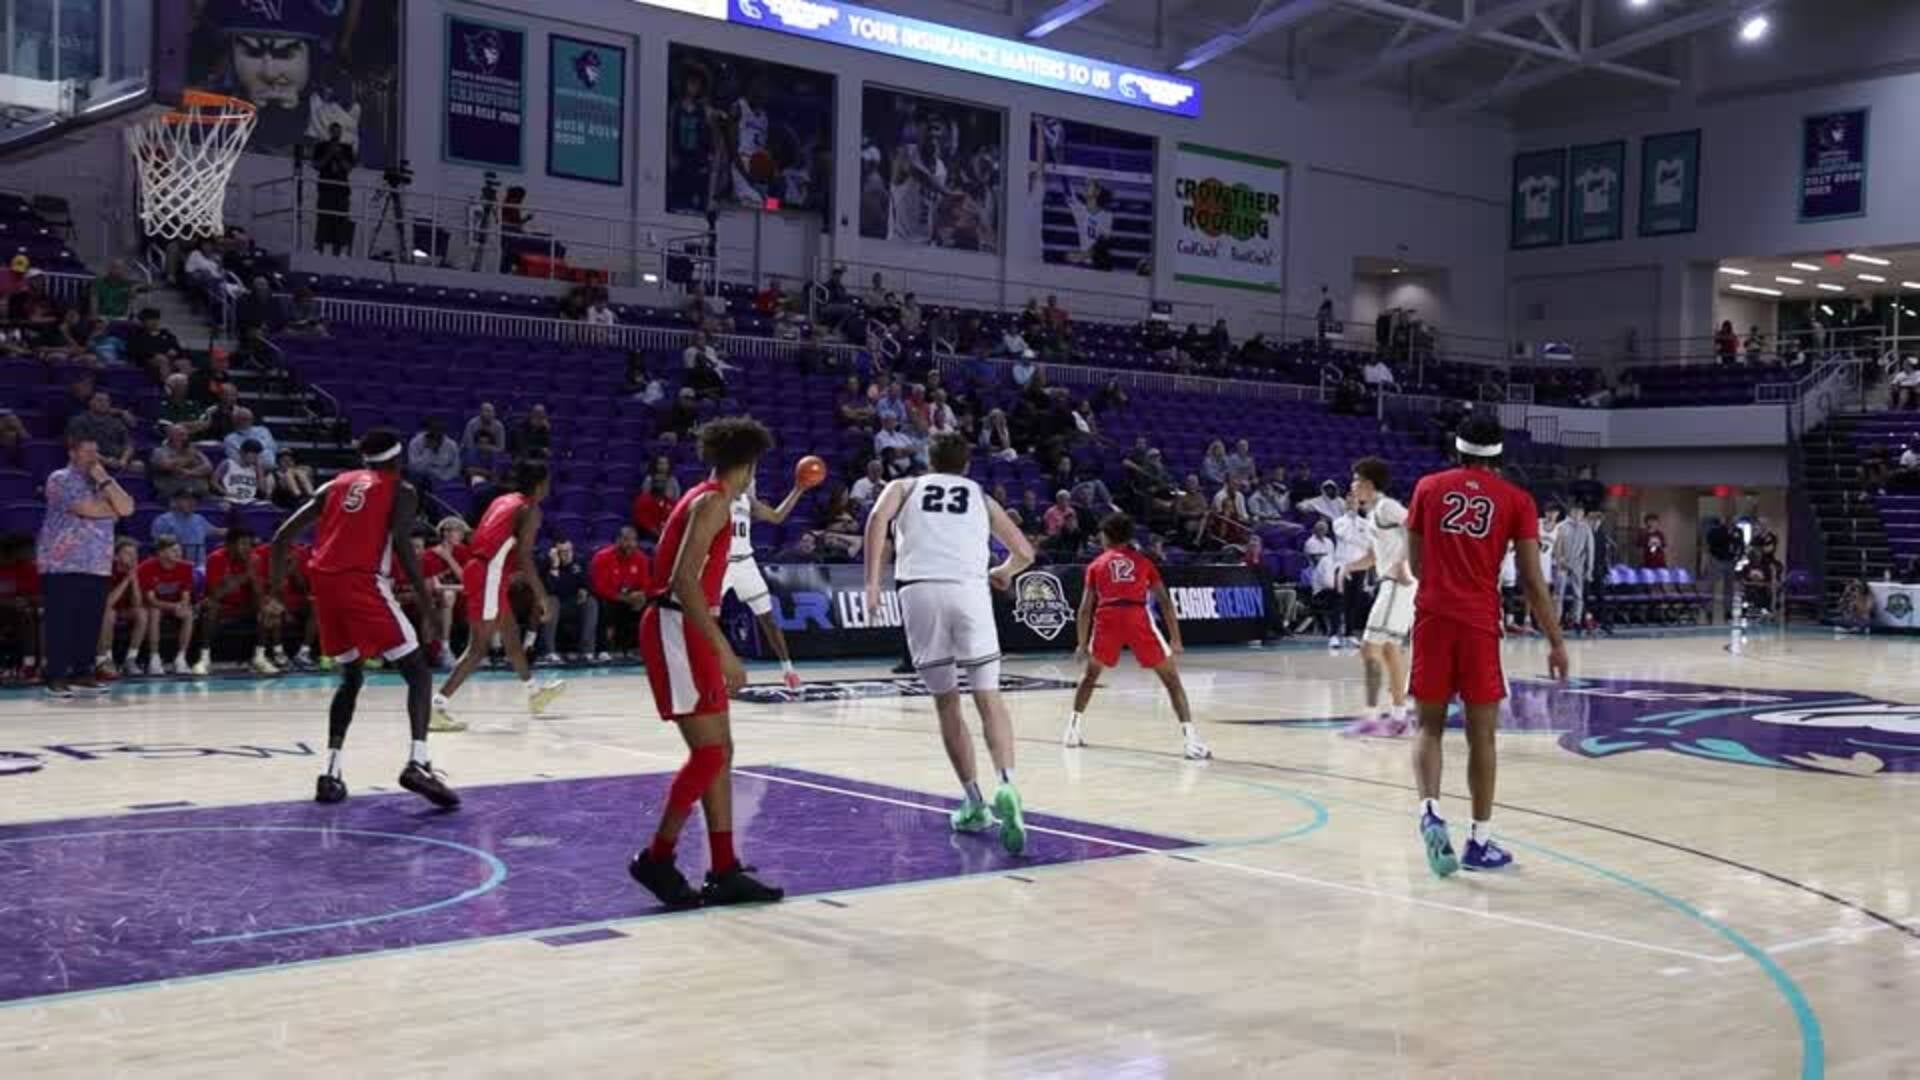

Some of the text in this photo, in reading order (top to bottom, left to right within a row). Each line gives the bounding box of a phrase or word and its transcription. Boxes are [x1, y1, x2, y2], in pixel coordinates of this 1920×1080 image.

[849, 15, 899, 45] YOUR
[998, 47, 1067, 81] MATTERS
[1068, 62, 1090, 85] TO
[1092, 69, 1111, 89] US
[1176, 177, 1280, 217] CROWTHER
[1183, 205, 1269, 240] ROOFING
[343, 481, 371, 513] 5
[922, 484, 969, 514] 23
[1441, 491, 1494, 538] 23
[1108, 558, 1136, 583] 12
